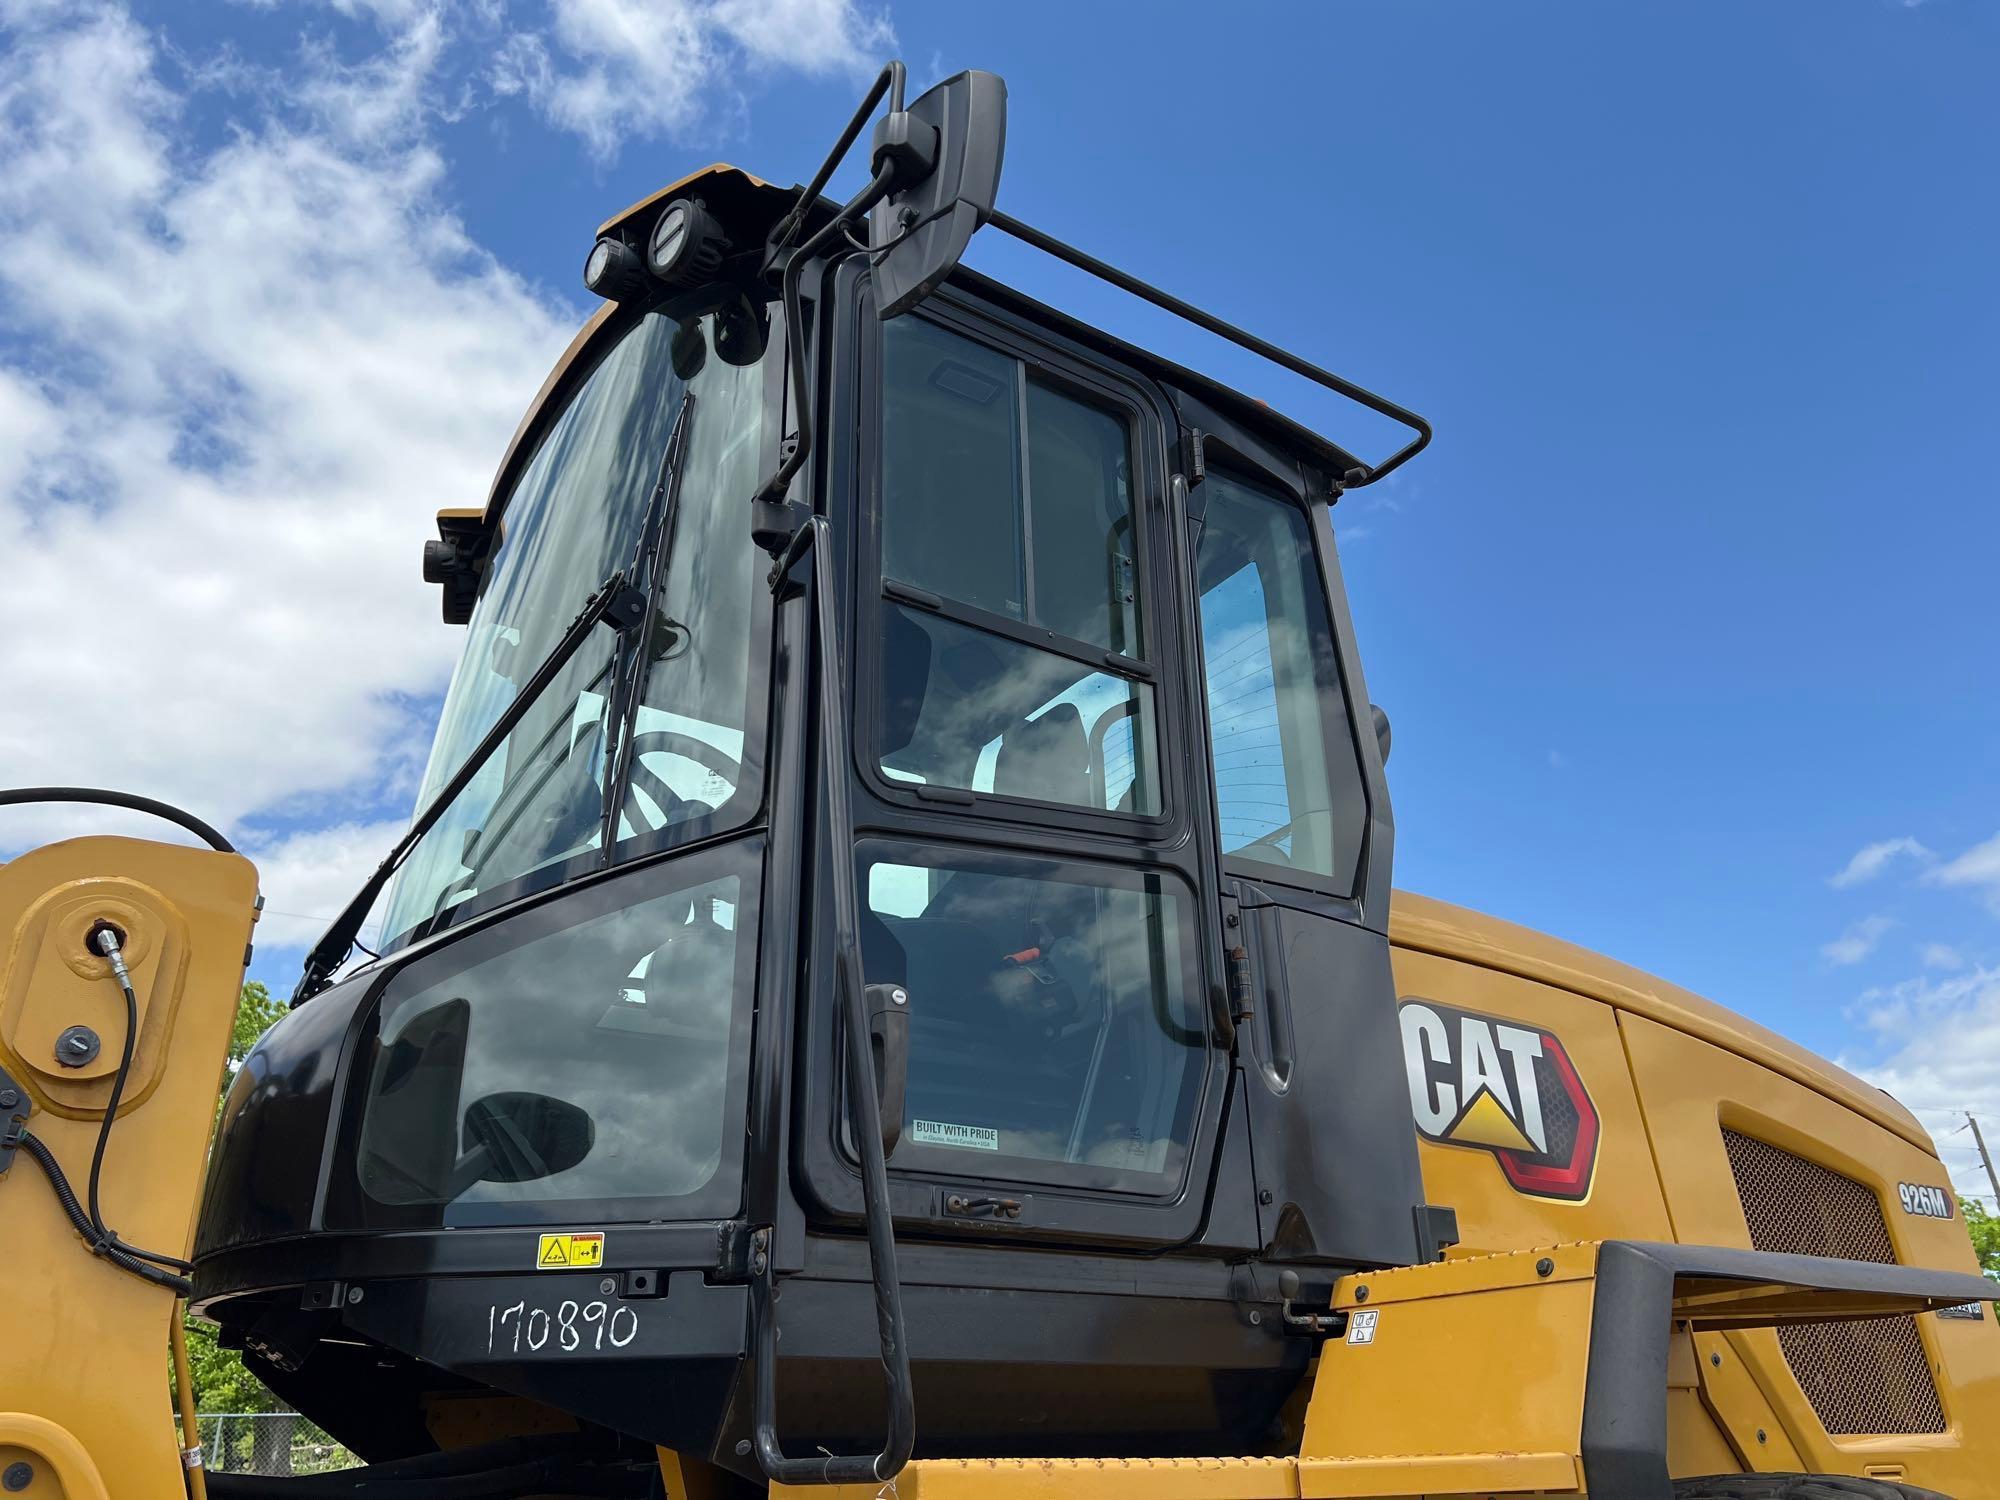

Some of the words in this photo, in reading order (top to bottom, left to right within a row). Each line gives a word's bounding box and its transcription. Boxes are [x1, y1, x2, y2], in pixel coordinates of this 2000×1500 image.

[1399, 1004, 1548, 1154] CAT
[916, 1121, 942, 1134] BUILT
[943, 1124, 968, 1137] WITH
[970, 1128, 996, 1141] PRIDE
[1899, 1183, 1948, 1217] 926M
[489, 1300, 638, 1355] 170890
